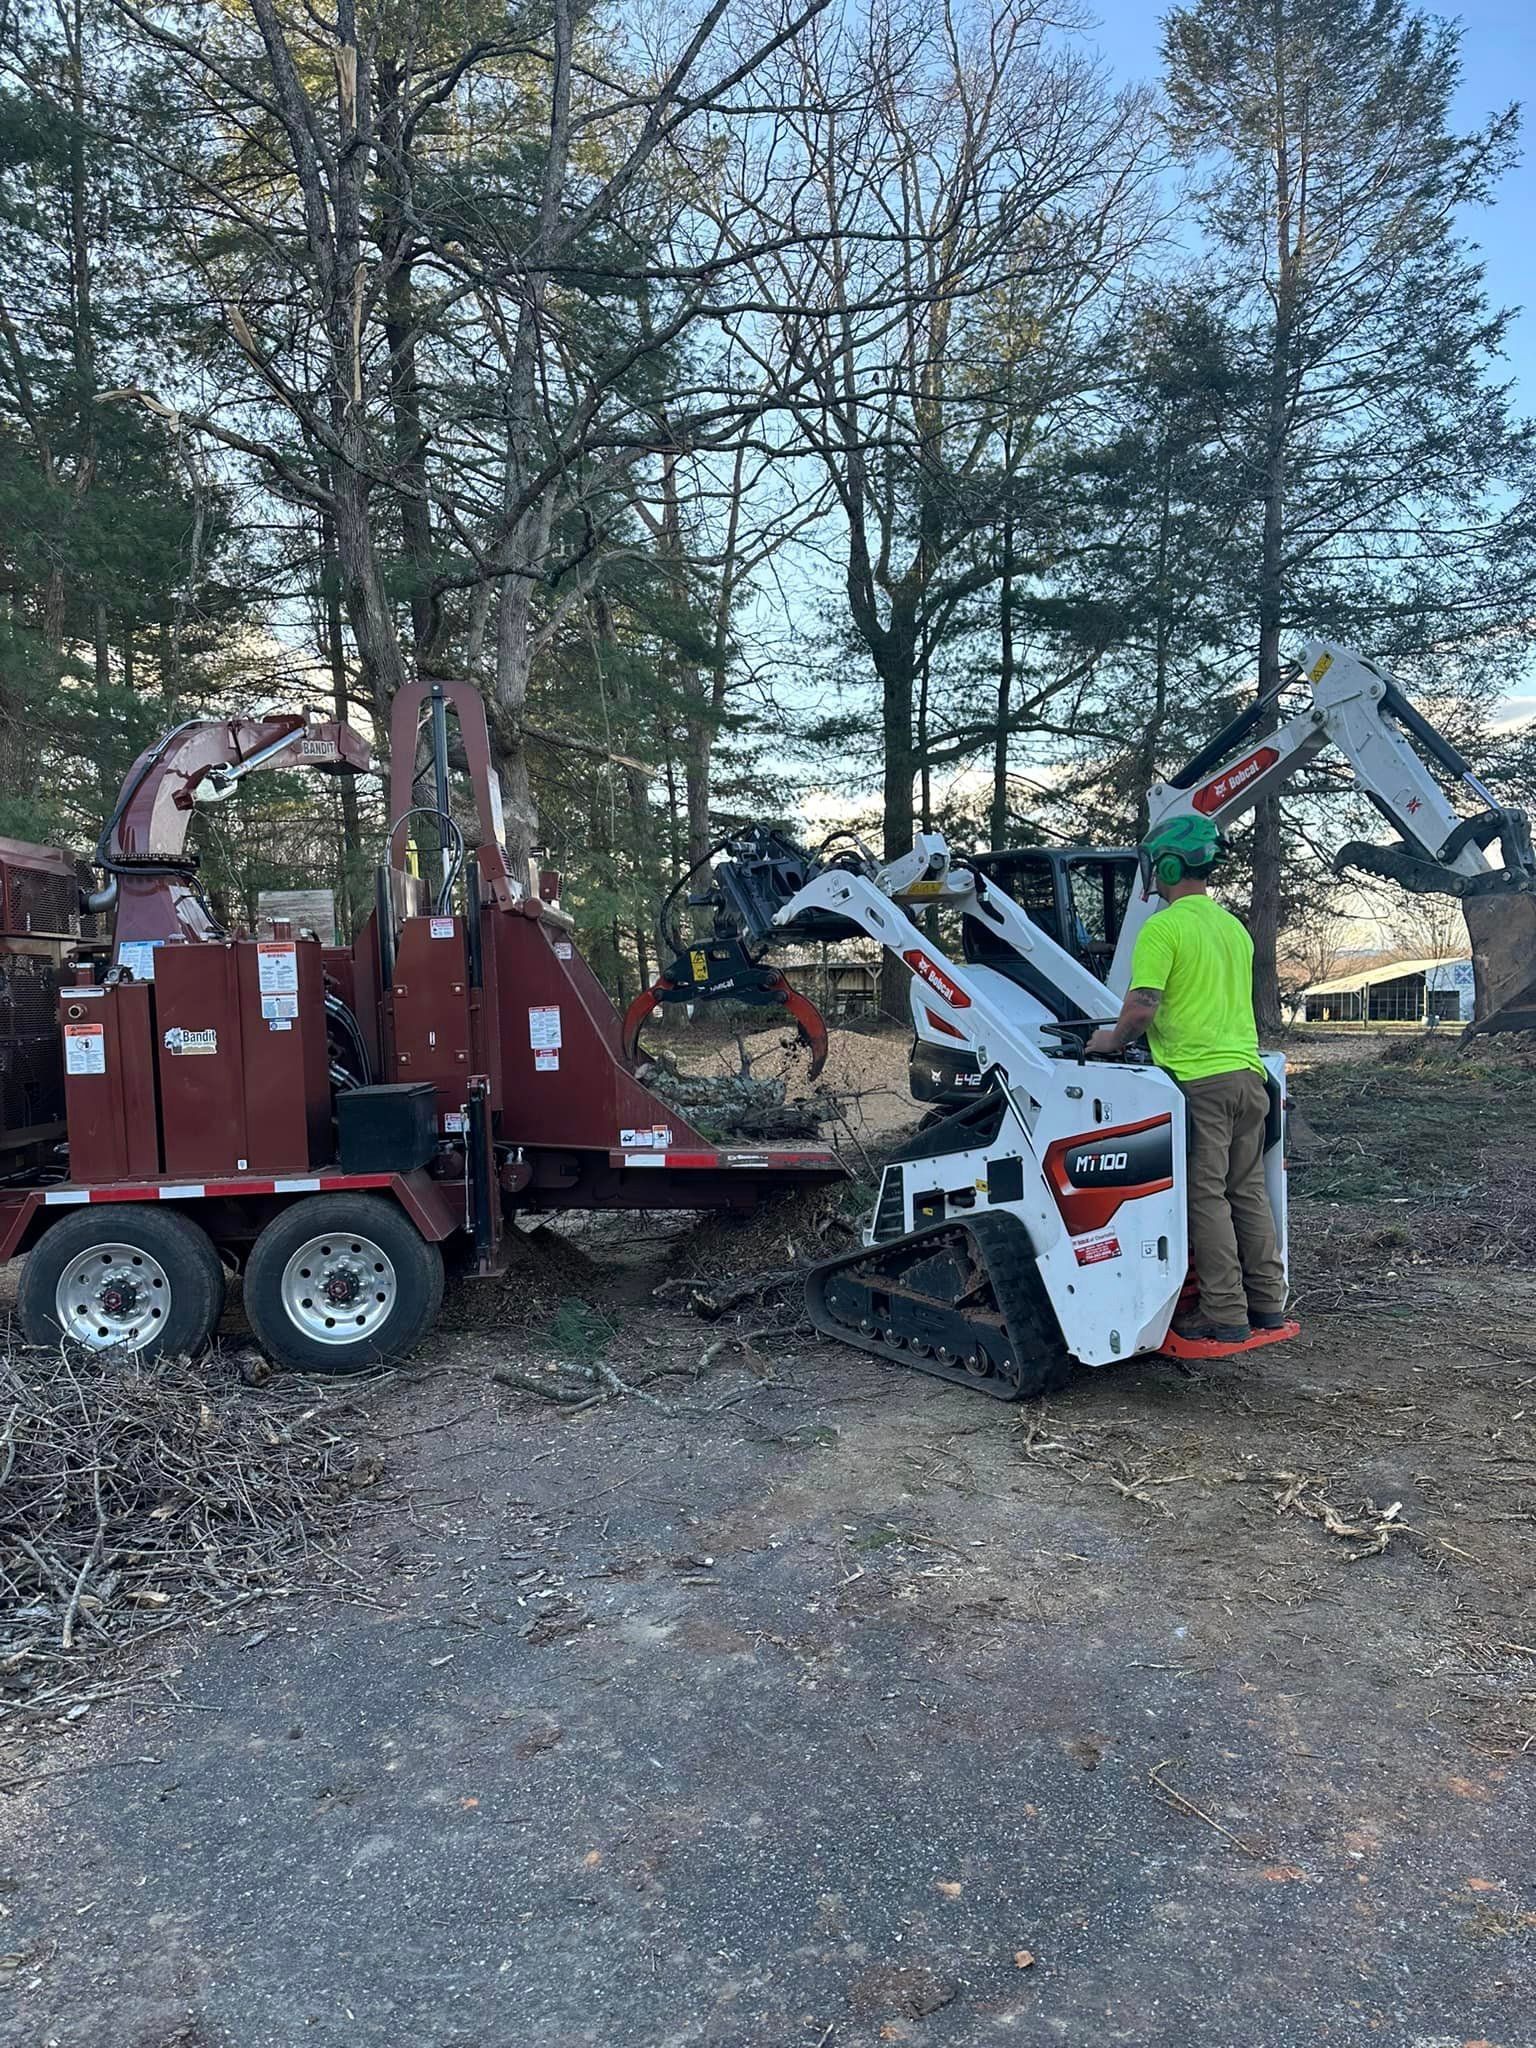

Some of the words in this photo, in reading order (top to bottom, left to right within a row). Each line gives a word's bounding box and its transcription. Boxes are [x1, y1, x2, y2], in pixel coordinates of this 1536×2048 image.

[303, 742, 334, 755] BANDIT
[1228, 760, 1260, 790] Bobcat
[928, 970, 954, 1001] Bobcat
[182, 1030, 216, 1043] Bandit
[954, 1073, 982, 1086] E42
[1075, 1152, 1128, 1173] MT100
